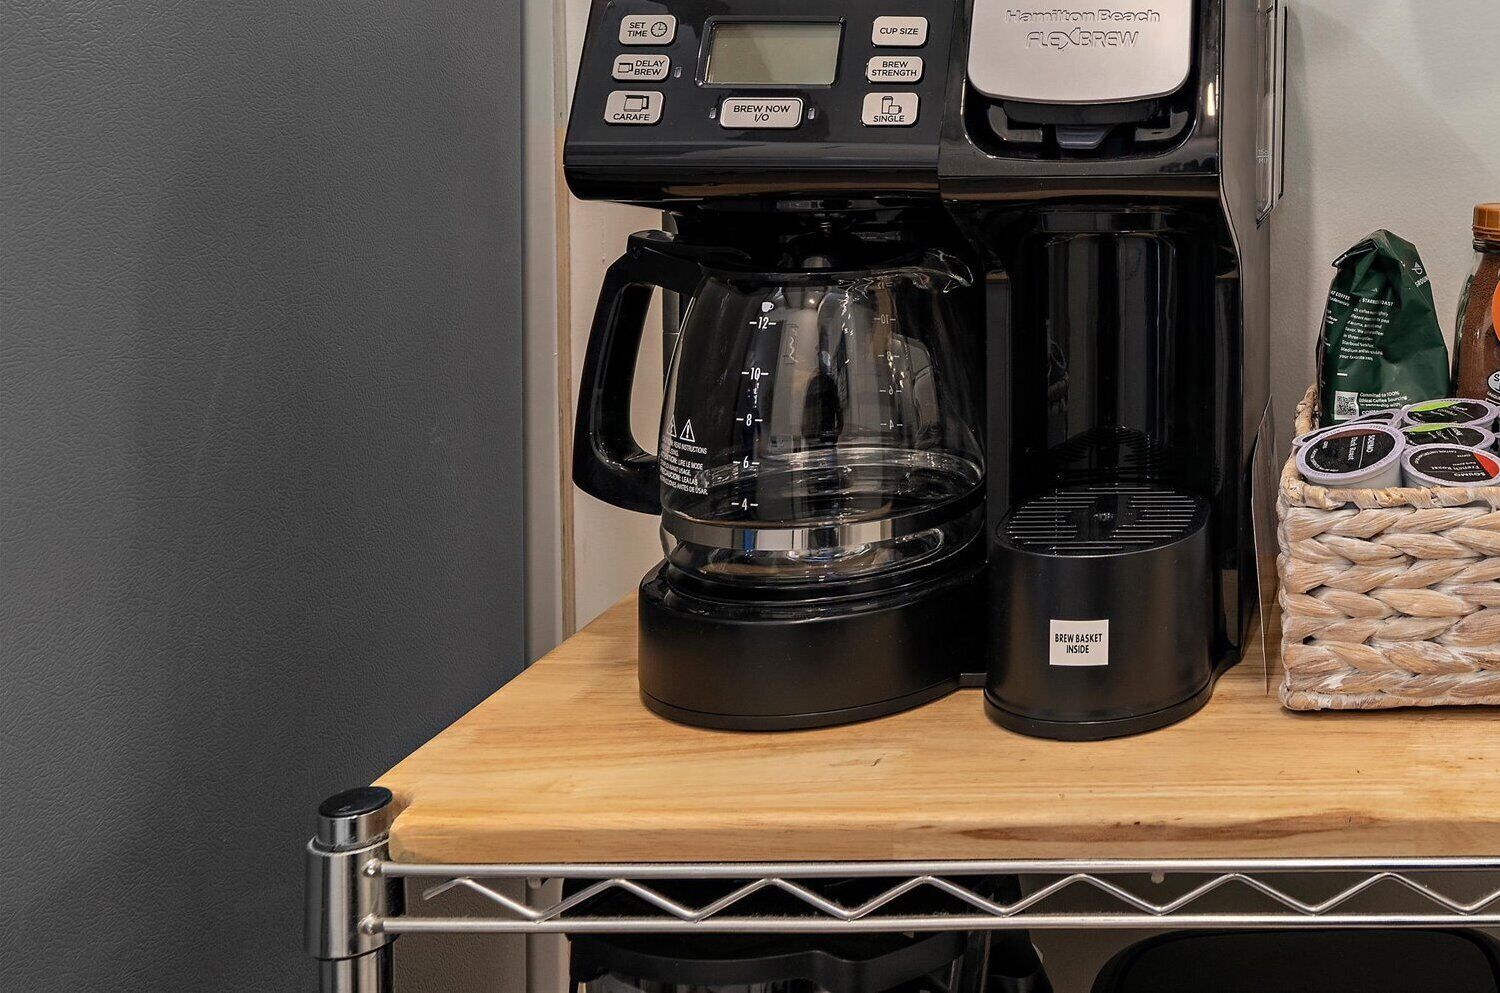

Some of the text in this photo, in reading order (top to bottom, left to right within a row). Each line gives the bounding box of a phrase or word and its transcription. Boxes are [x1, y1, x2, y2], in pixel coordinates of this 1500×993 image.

[1005, 9, 1161, 23] Hamilton Beach
[879, 27, 919, 35] CUP SIZE
[1025, 27, 1139, 50] FLEXBREW
[634, 68, 662, 76] BREW
[871, 69, 917, 77] STRENGTH
[733, 105, 791, 113] BREW NOW
[613, 113, 651, 121] CARAFE
[754, 113, 769, 122] I/O
[873, 115, 904, 123] SINGLE
[757, 316, 769, 330] 12
[750, 367, 761, 381] 10
[745, 414, 752, 426] 8
[743, 456, 749, 469] 6
[741, 498, 748, 511] 4
[1055, 633, 1103, 643] BREW BASKET
[1066, 644, 1090, 654] INSIDE
